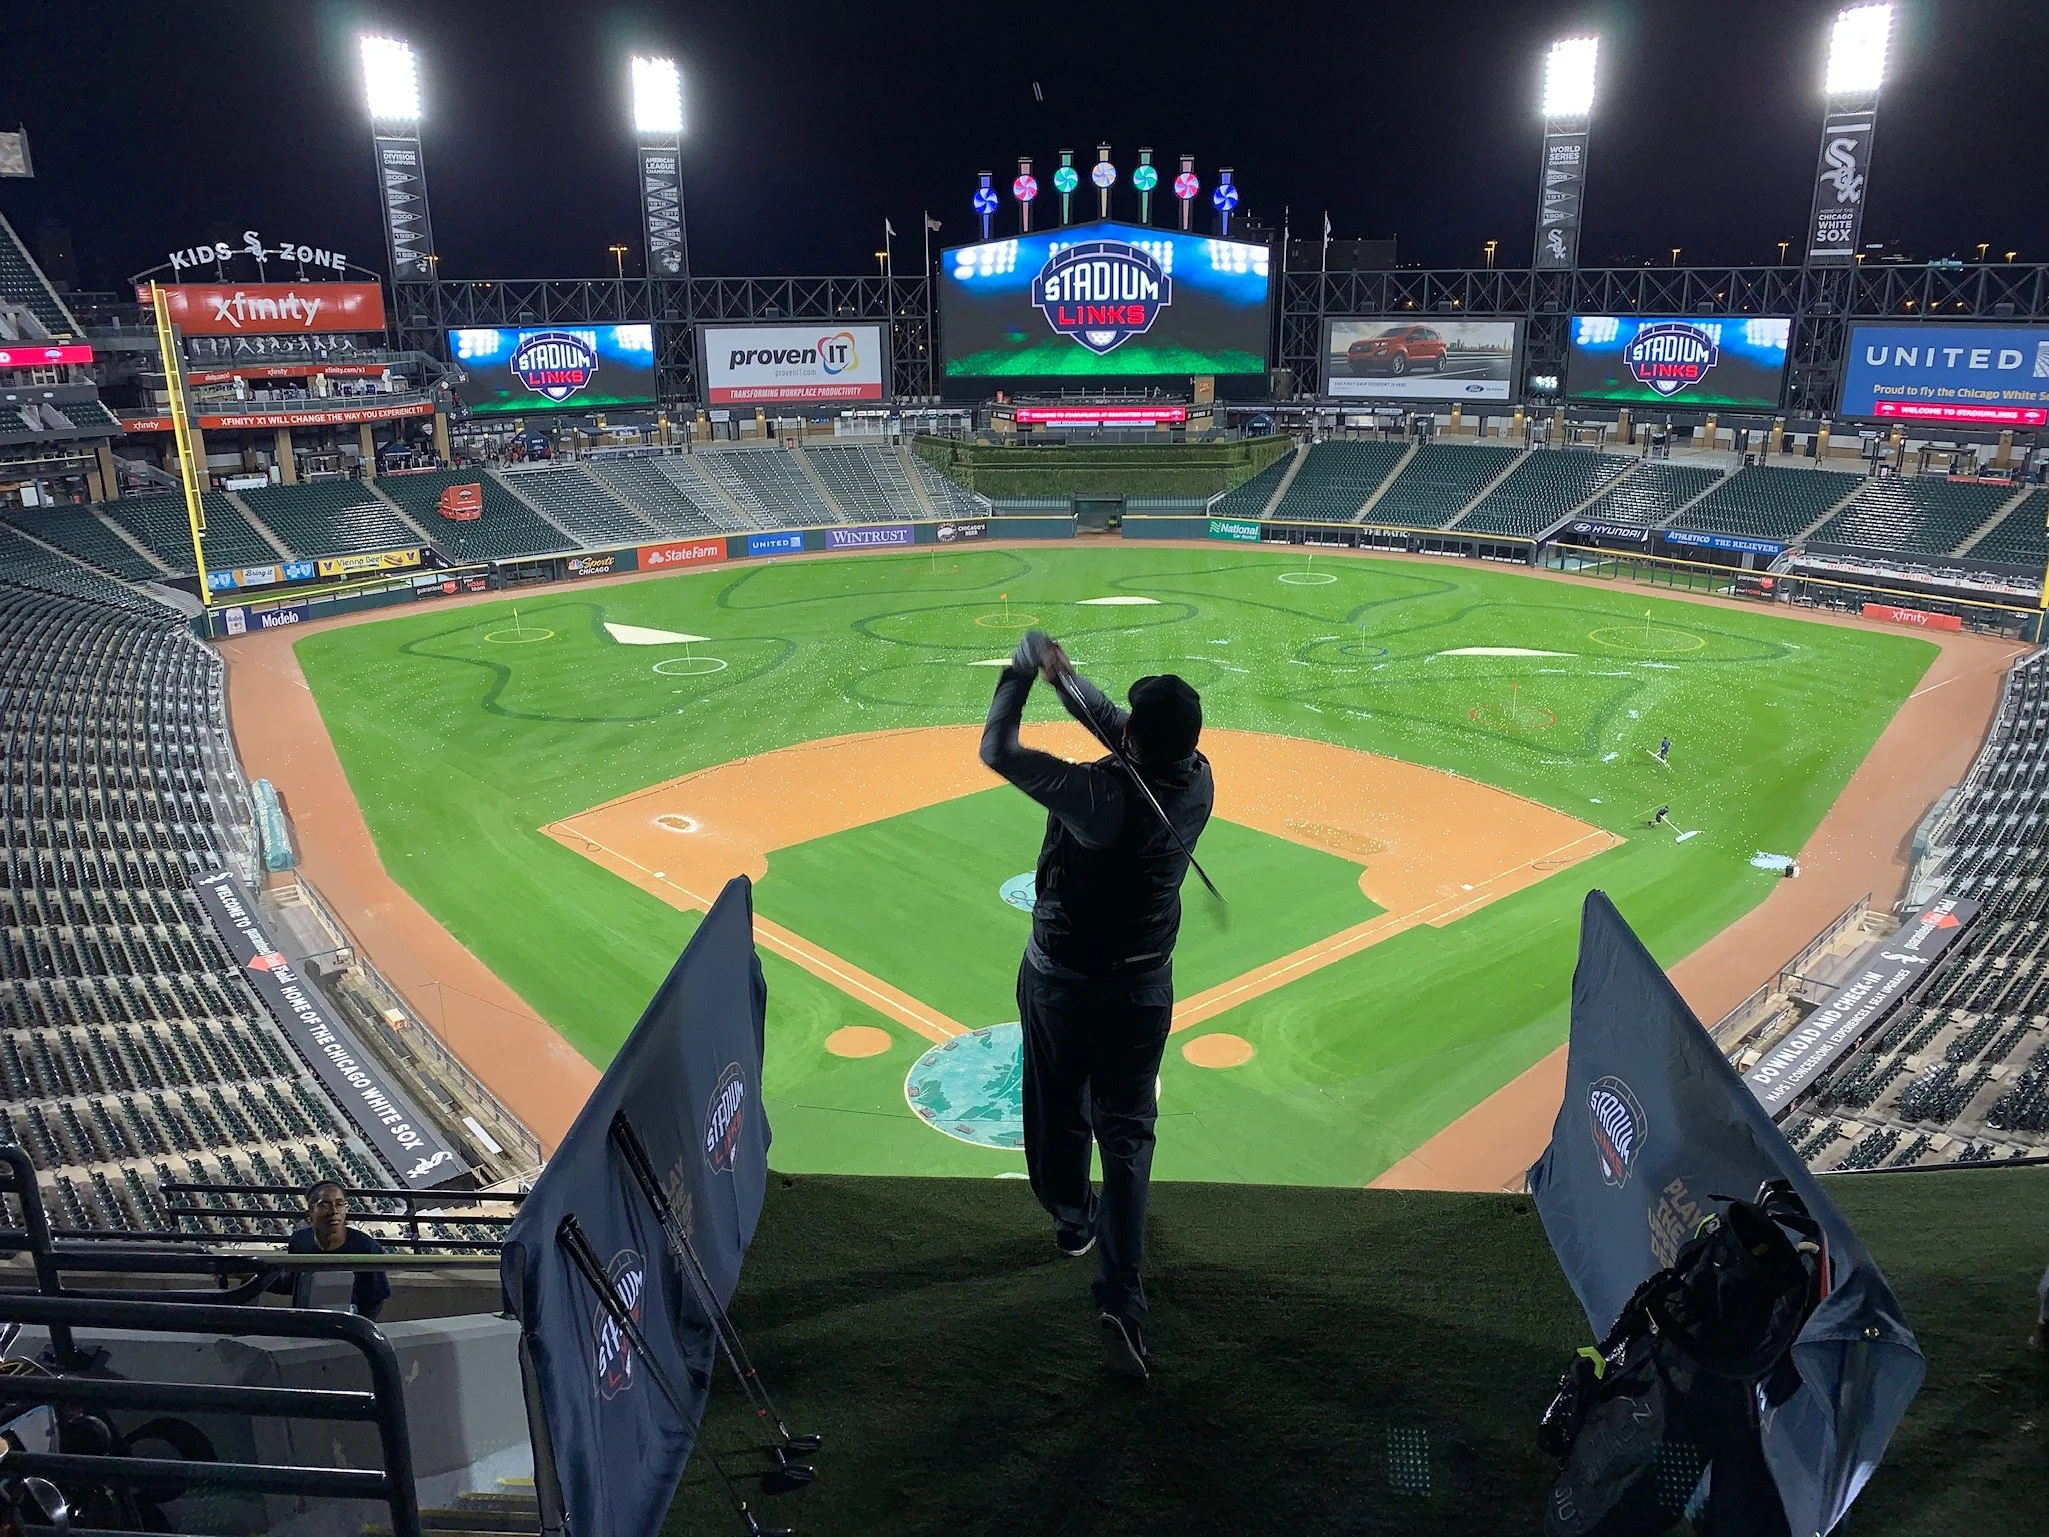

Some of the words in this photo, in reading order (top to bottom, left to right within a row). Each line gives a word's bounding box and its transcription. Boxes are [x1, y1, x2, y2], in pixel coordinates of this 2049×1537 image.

[1549, 153, 1580, 161] SERIES
[1818, 220, 1852, 229] WHITE
[1816, 229, 1851, 242] SOX
[169, 242, 233, 271] KIDS
[280, 243, 346, 272] ZONE
[1044, 262, 1158, 302] STADIUM
[214, 291, 320, 328] xfinity
[1058, 305, 1145, 325] LINKS
[518, 340, 590, 370] STADIUM
[729, 344, 817, 370] proven
[828, 345, 848, 363] IT
[1632, 336, 1709, 363] STADIUM
[1866, 346, 2023, 370] UNITED
[324, 365, 366, 375] xfinity.com/x1
[528, 368, 584, 386] LINKS
[1640, 364, 1699, 378] LINKS
[730, 389, 778, 399] TRANSFORMING
[780, 388, 816, 397] WORKPLACE
[817, 387, 862, 396] PRODUCTIVITY
[1874, 384, 1904, 395] Proud
[1907, 386, 1917, 395] to
[1920, 386, 1934, 397] fly
[1937, 387, 1954, 397] the
[1957, 388, 2000, 400] Chicago
[2003, 390, 2036, 400] White
[221, 415, 254, 426] XFINITY
[256, 415, 266, 424] X1
[267, 414, 289, 423] WILL
[290, 412, 326, 423] CHANGE
[327, 412, 342, 421] THE
[342, 410, 360, 420] WAY
[360, 409, 377, 418] YOU
[378, 407, 415, 417] EXPERIENCE
[1901, 406, 1941, 415] WELCOME
[1956, 409, 2018, 419] STADIUMLINKS
[132, 420, 160, 430] xfinity
[832, 529, 907, 544] WINTRUST
[957, 524, 986, 532] CHICAGO'S
[1220, 522, 1259, 536] National
[1363, 528, 1378, 537] THE
[1592, 526, 1642, 539] HYUNDAI
[752, 539, 789, 549] UNITED
[1668, 531, 1710, 543] ATHLETICO
[1732, 540, 1779, 553] RELIEVERS
[336, 556, 364, 567] Vienna
[365, 555, 382, 564] Beef
[578, 566, 609, 575] CHICAGO
[582, 556, 615, 568] Sports
[245, 569, 263, 577] Bring
[262, 611, 299, 628] Modelo
[1892, 609, 1929, 625] xfinity
[214, 884, 241, 919] WELCOME
[236, 915, 251, 928] TO
[1904, 922, 1937, 950] guaranteed
[1934, 899, 1958, 914] Field
[242, 928, 274, 956] guaranteed
[271, 964, 290, 984] Field
[281, 985, 310, 1016] HOME
[300, 1010, 318, 1031] OF
[1752, 1027, 1821, 1085] DOWNLOAD
[1816, 1003, 1843, 1031] AND
[1834, 972, 1884, 1011] CHECK-IN
[310, 1027, 336, 1051] THE
[1766, 1081, 1791, 1102] MAPS
[1792, 1044, 1833, 1086] CONCESSIONS
[1832, 1010, 1870, 1043] EXPERIENCES
[1869, 992, 1886, 1010] SEAT
[1883, 969, 1911, 995] UPGRADES
[324, 1043, 371, 1088] CHICAGO
[362, 1086, 400, 1125] WHITE
[707, 1080, 743, 1152] STADIUM
[392, 1120, 424, 1151] SOX
[1590, 1090, 1633, 1165] STADIUM
[1593, 1120, 1622, 1178] LINKS
